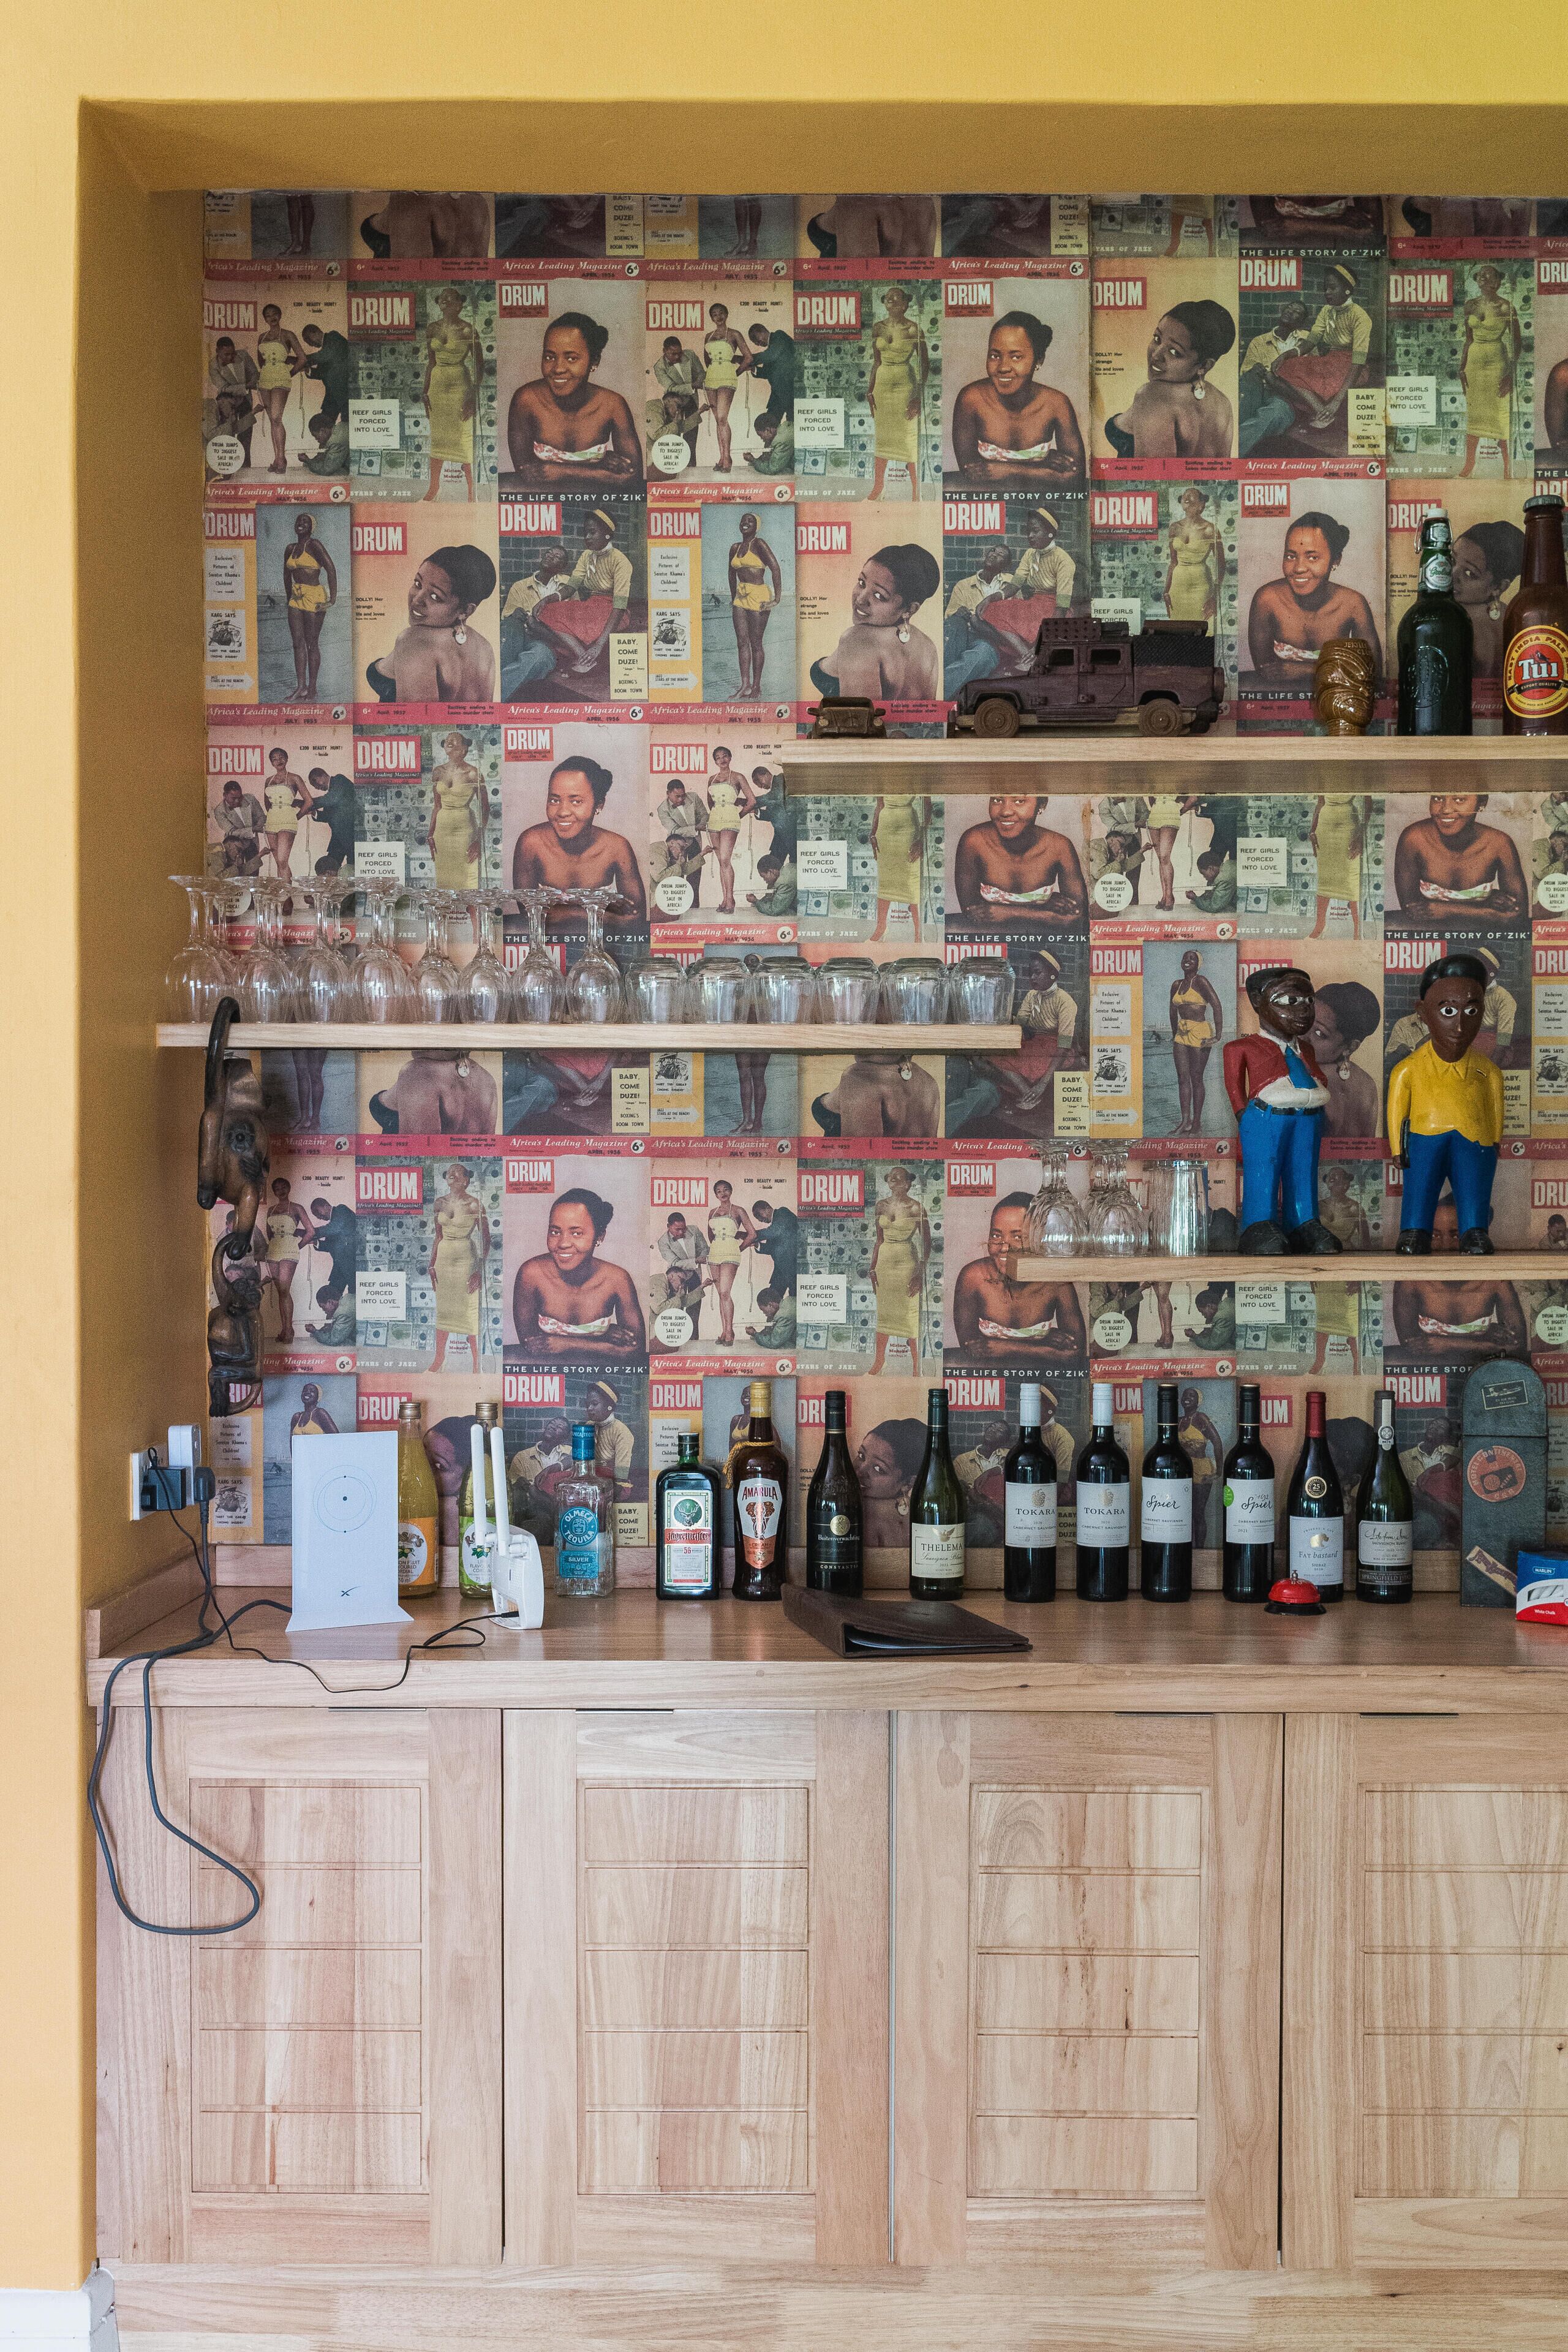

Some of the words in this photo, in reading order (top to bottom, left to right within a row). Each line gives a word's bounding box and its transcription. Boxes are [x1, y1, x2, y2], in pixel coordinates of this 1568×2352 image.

[503, 262, 535, 271] Africa's
[539, 262, 576, 271] Leading
[579, 262, 622, 271] Magazine
[1242, 260, 1297, 286] DRUM
[502, 286, 545, 305] DRUM
[948, 285, 991, 305] DRUM
[1094, 282, 1142, 306] DRUM
[1390, 275, 1447, 303] DRUM
[204, 303, 254, 328] DRUM
[352, 298, 410, 326] DRUM
[649, 304, 701, 328] DRUM
[798, 297, 856, 325] DRUM
[1245, 486, 1287, 505] DRUM
[501, 505, 556, 532] DRUM
[944, 504, 1000, 530] DRUM
[1095, 497, 1152, 526] DRUM
[205, 513, 254, 536] DRUM
[651, 513, 699, 536] DRUM
[353, 527, 402, 551] DRUM
[797, 527, 846, 550] DRUM
[1515, 636, 1541, 654] INDIA
[1545, 636, 1566, 654] PALE
[1518, 658, 1558, 680] Tui
[650, 706, 685, 714] Africa's
[688, 706, 723, 715] Leading
[725, 706, 768, 715] Magazine
[507, 730, 550, 749] DRUM
[208, 748, 261, 772] DRUM
[358, 741, 416, 770] DRUM
[653, 747, 704, 771] DRUM
[1092, 924, 1123, 933] Africa's
[1126, 924, 1161, 934] Leading
[1163, 924, 1205, 933] Magazine
[1092, 950, 1141, 973] DRUM
[1385, 943, 1441, 969] DRUM
[509, 1162, 551, 1182] DRUM
[951, 1166, 993, 1185] DRUM
[360, 1172, 417, 1199] DRUM
[654, 1181, 705, 1204] DRUM
[802, 1175, 859, 1202] DRUM
[504, 1376, 559, 1403] DRUM
[653, 1385, 701, 1408] DRUM
[742, 1486, 778, 1501] AMARULA
[1146, 1494, 1180, 1512] Spier
[565, 1507, 592, 1523] OLMECA
[565, 1530, 595, 1544] TEQUILA
